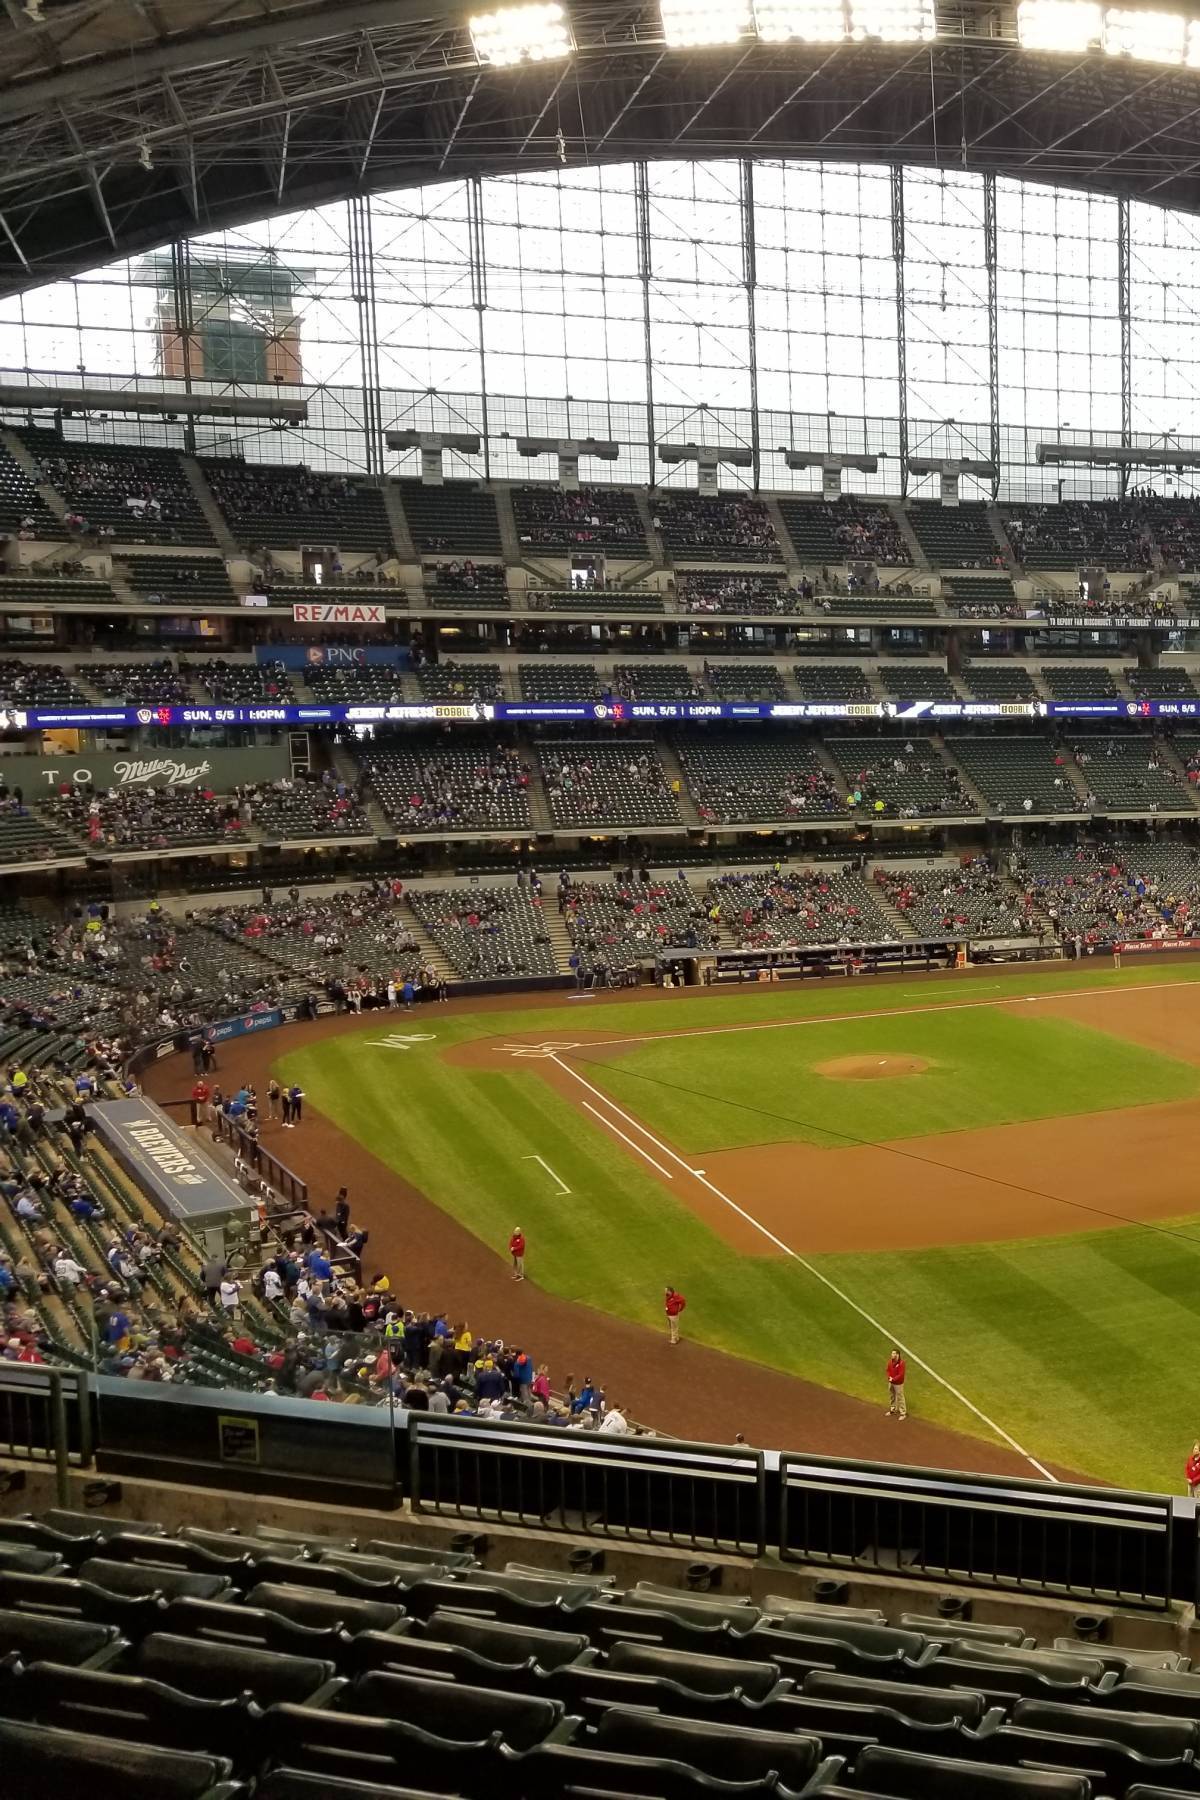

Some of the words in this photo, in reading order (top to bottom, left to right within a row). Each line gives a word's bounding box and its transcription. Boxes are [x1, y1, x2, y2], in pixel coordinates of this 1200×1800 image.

[295, 605, 381, 622] RE/MAX
[327, 647, 366, 662] PNC
[436, 707, 471, 717] BOBBLE
[847, 705, 878, 714] BOBBLE
[42, 769, 93, 785] TO
[113, 759, 175, 786] Miller
[161, 760, 211, 788] Park
[254, 1015, 272, 1027] pepsi
[216, 1025, 232, 1037] pepsi
[129, 1127, 196, 1174] BREWERS
